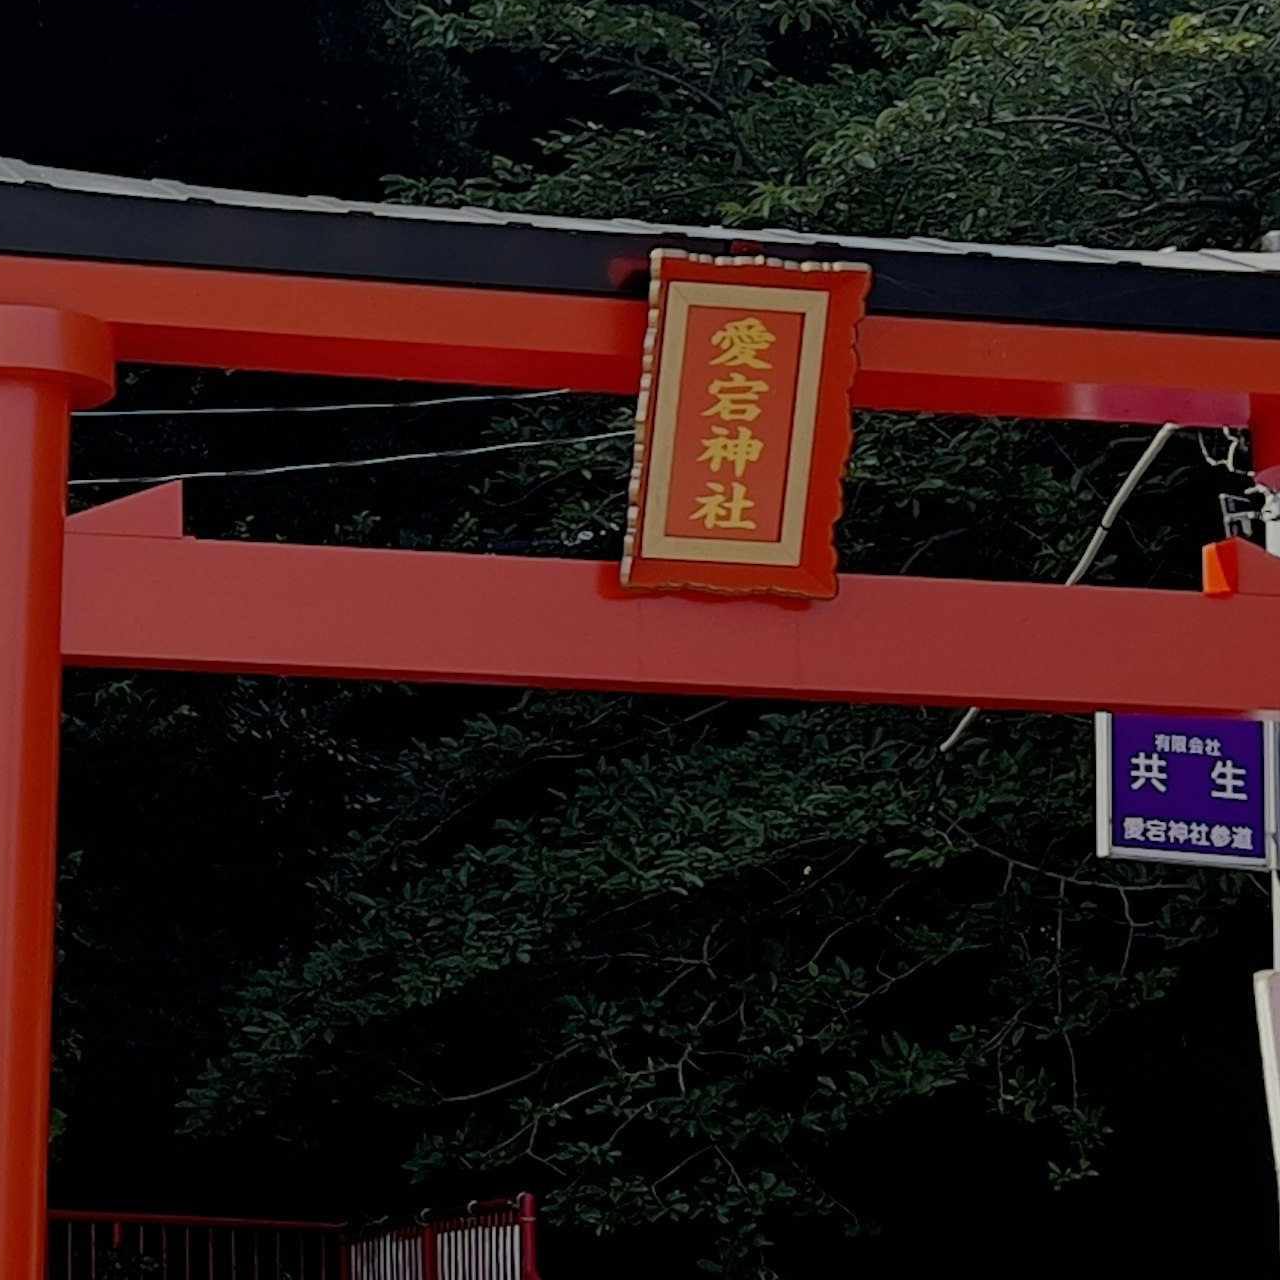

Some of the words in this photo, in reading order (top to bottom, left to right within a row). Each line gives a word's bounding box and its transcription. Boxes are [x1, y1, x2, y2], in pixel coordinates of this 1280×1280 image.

[689, 316, 776, 529] 愛宕神社
[1155, 734, 1221, 756] 有限会社
[1123, 817, 1253, 850] 愛宕神社参道
